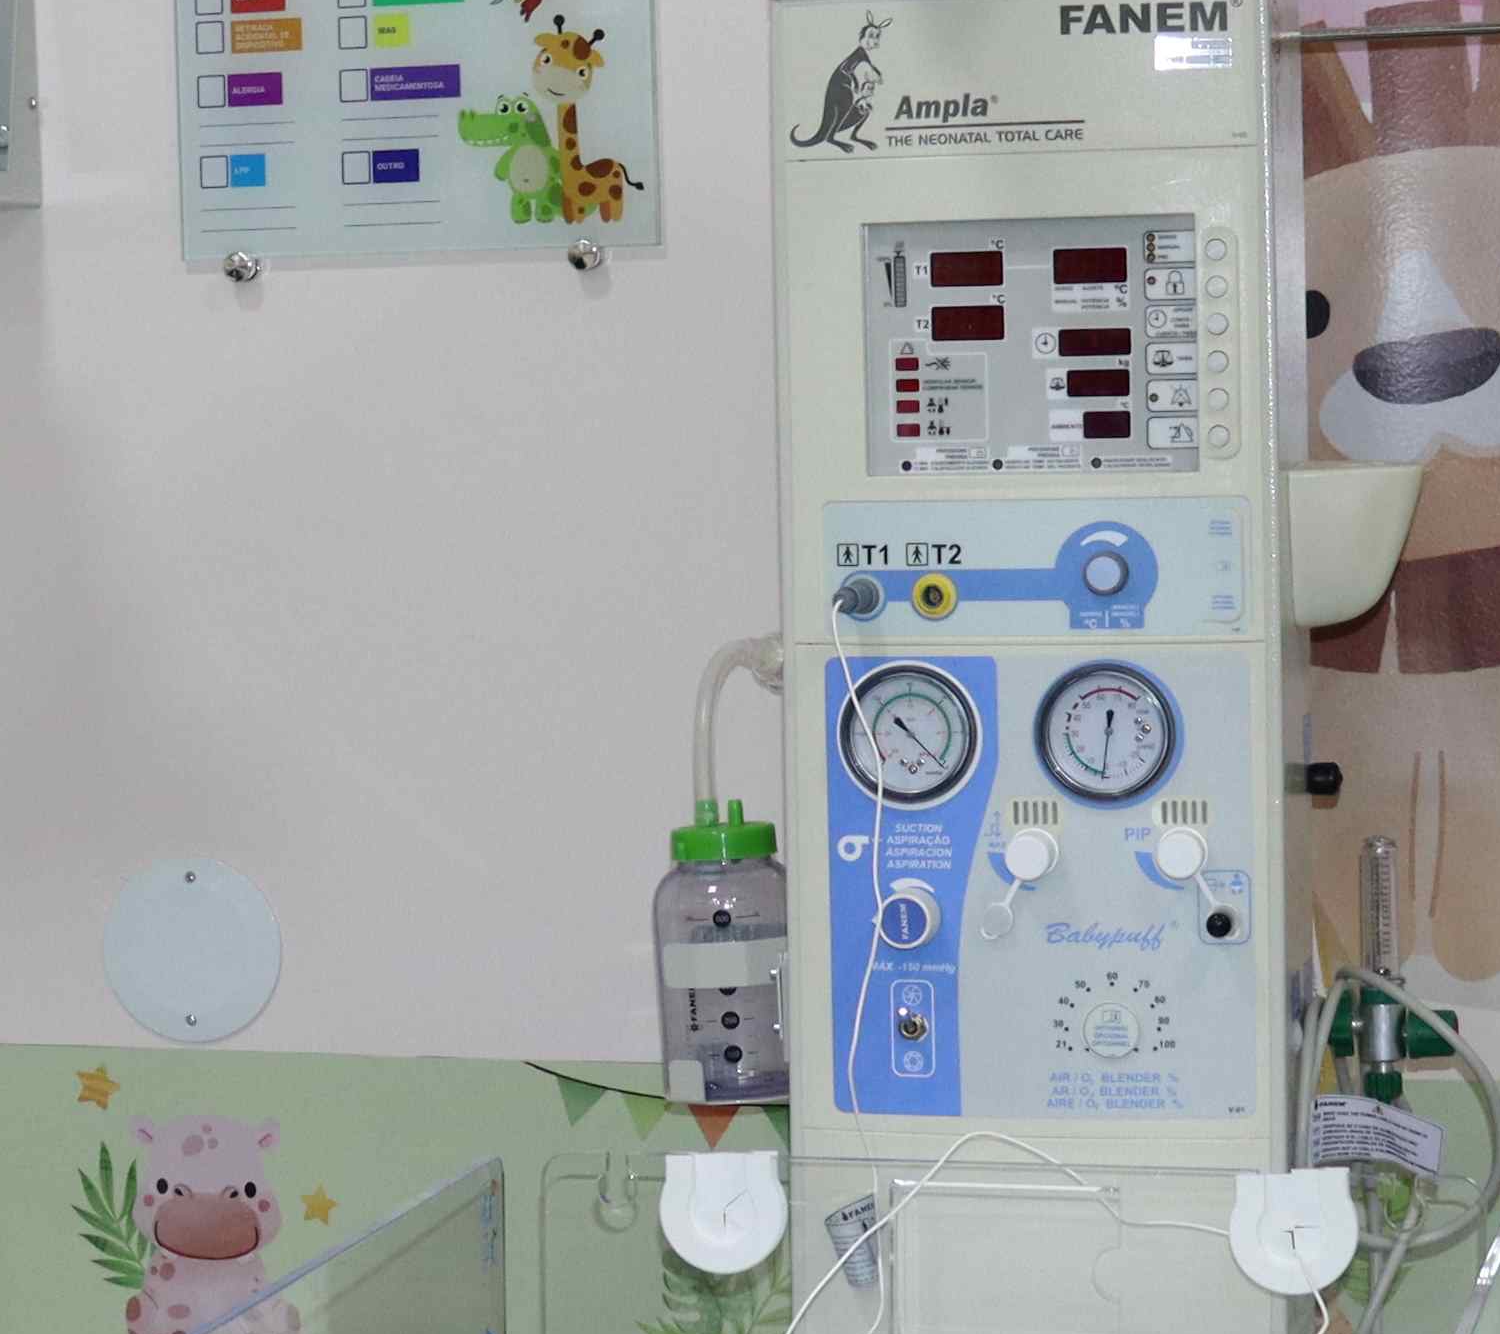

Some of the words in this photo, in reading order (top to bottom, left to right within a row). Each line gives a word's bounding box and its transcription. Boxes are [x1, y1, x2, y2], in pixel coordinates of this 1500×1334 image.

[886, 134, 913, 147] THE
[918, 132, 992, 147] NEONATAL
[997, 130, 1041, 144] TOTAL
[1045, 127, 1084, 142] CARE
[915, 266, 928, 275] T1
[916, 320, 929, 329] T2
[861, 545, 890, 565] T1
[932, 543, 962, 565] T2
[895, 823, 943, 833] SUCTION
[1124, 828, 1151, 842] PIP
[887, 859, 952, 869] ASPIRATION
[1107, 972, 1118, 980] 60
[1138, 980, 1150, 988] 70
[1058, 997, 1069, 1005] 40
[1056, 1040, 1067, 1048] 21
[1159, 1040, 1176, 1049] 100
[1101, 1072, 1161, 1082] BLENDER
[1099, 1086, 1160, 1096] BLENDER
[1106, 1099, 1165, 1108] BLENDER
